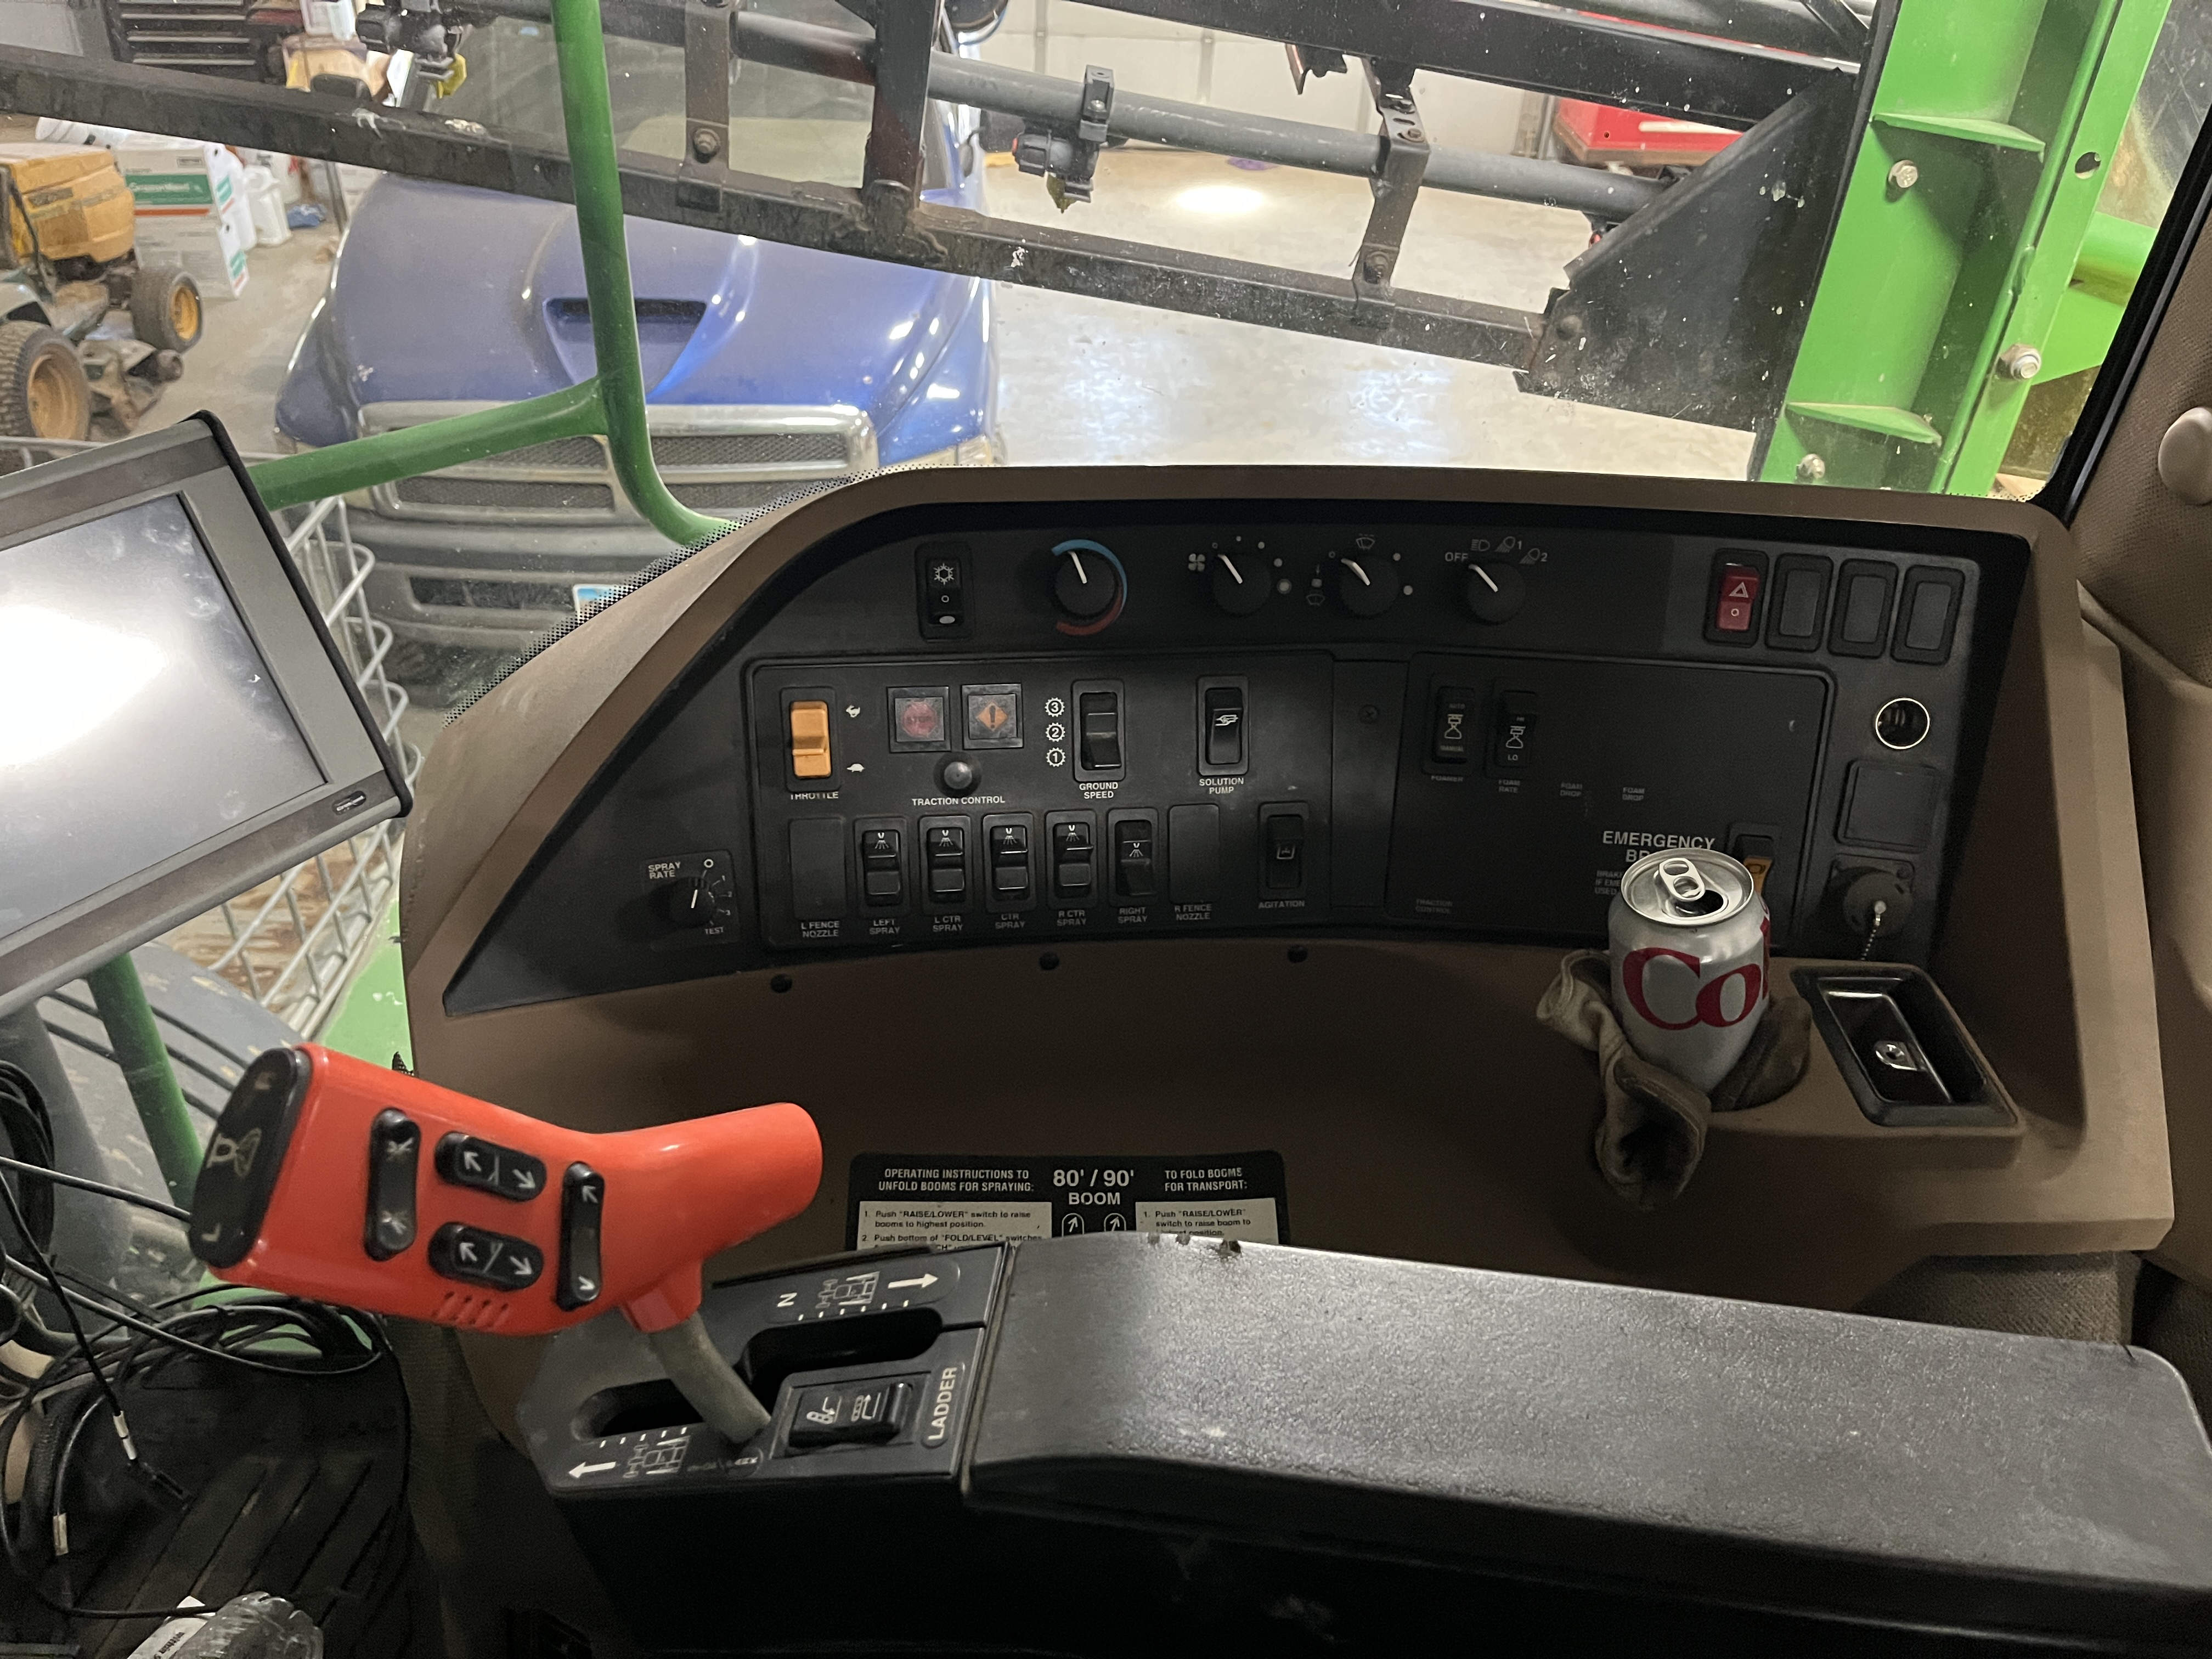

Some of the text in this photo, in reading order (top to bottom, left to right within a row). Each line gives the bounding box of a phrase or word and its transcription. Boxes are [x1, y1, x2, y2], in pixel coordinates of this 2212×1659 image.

[1444, 551, 1469, 562] OFF
[1079, 782, 1119, 791] GROUND
[1199, 777, 1245, 787] SOLUTION
[1083, 790, 1114, 799] SPEED
[1209, 786, 1234, 795] PUMP
[790, 791, 839, 800] THROTTLE
[911, 795, 1006, 806] TRACTION CONTROL
[1602, 830, 1716, 849] EMERGENCY
[648, 861, 681, 872] SPRAY
[649, 870, 676, 879] RATE
[1182, 904, 1212, 912] FENCE
[1258, 900, 1306, 910] AGITATION
[1058, 909, 1086, 918] R CTR
[1119, 906, 1147, 916] RIGHT
[941, 915, 961, 923] CTR
[1000, 913, 1020, 921] CTR
[1118, 915, 1148, 923] SPRAY
[1176, 912, 1210, 921] NOZZLE
[809, 920, 840, 929] FENCE
[873, 918, 896, 927] LEFT
[995, 920, 1026, 930] SPRAY
[1057, 917, 1087, 927] SPRAY
[705, 926, 724, 935] TEST
[869, 926, 901, 935] SPRAY
[933, 923, 963, 932] SPRAY
[803, 929, 839, 939] NOZZLE
[884, 1169, 1029, 1179] OPERATING INSTRUCTIONS TO
[1053, 1169, 1085, 1186] 80'
[1103, 1170, 1134, 1187] 90'
[1165, 1167, 1243, 1180] TO FOLD BOOMS
[878, 1181, 1035, 1192] UNFOLD BOOMS FOR SPRAYING:
[1165, 1180, 1248, 1192] FOR TRANSPORT:
[1069, 1192, 1121, 1205] BOOM
[917, 1221, 947, 1229] highest
[898, 1234, 928, 1243] bottom
[930, 1234, 938, 1243] of
[777, 1293, 798, 1308] N
[928, 1367, 957, 1440] LADDER
